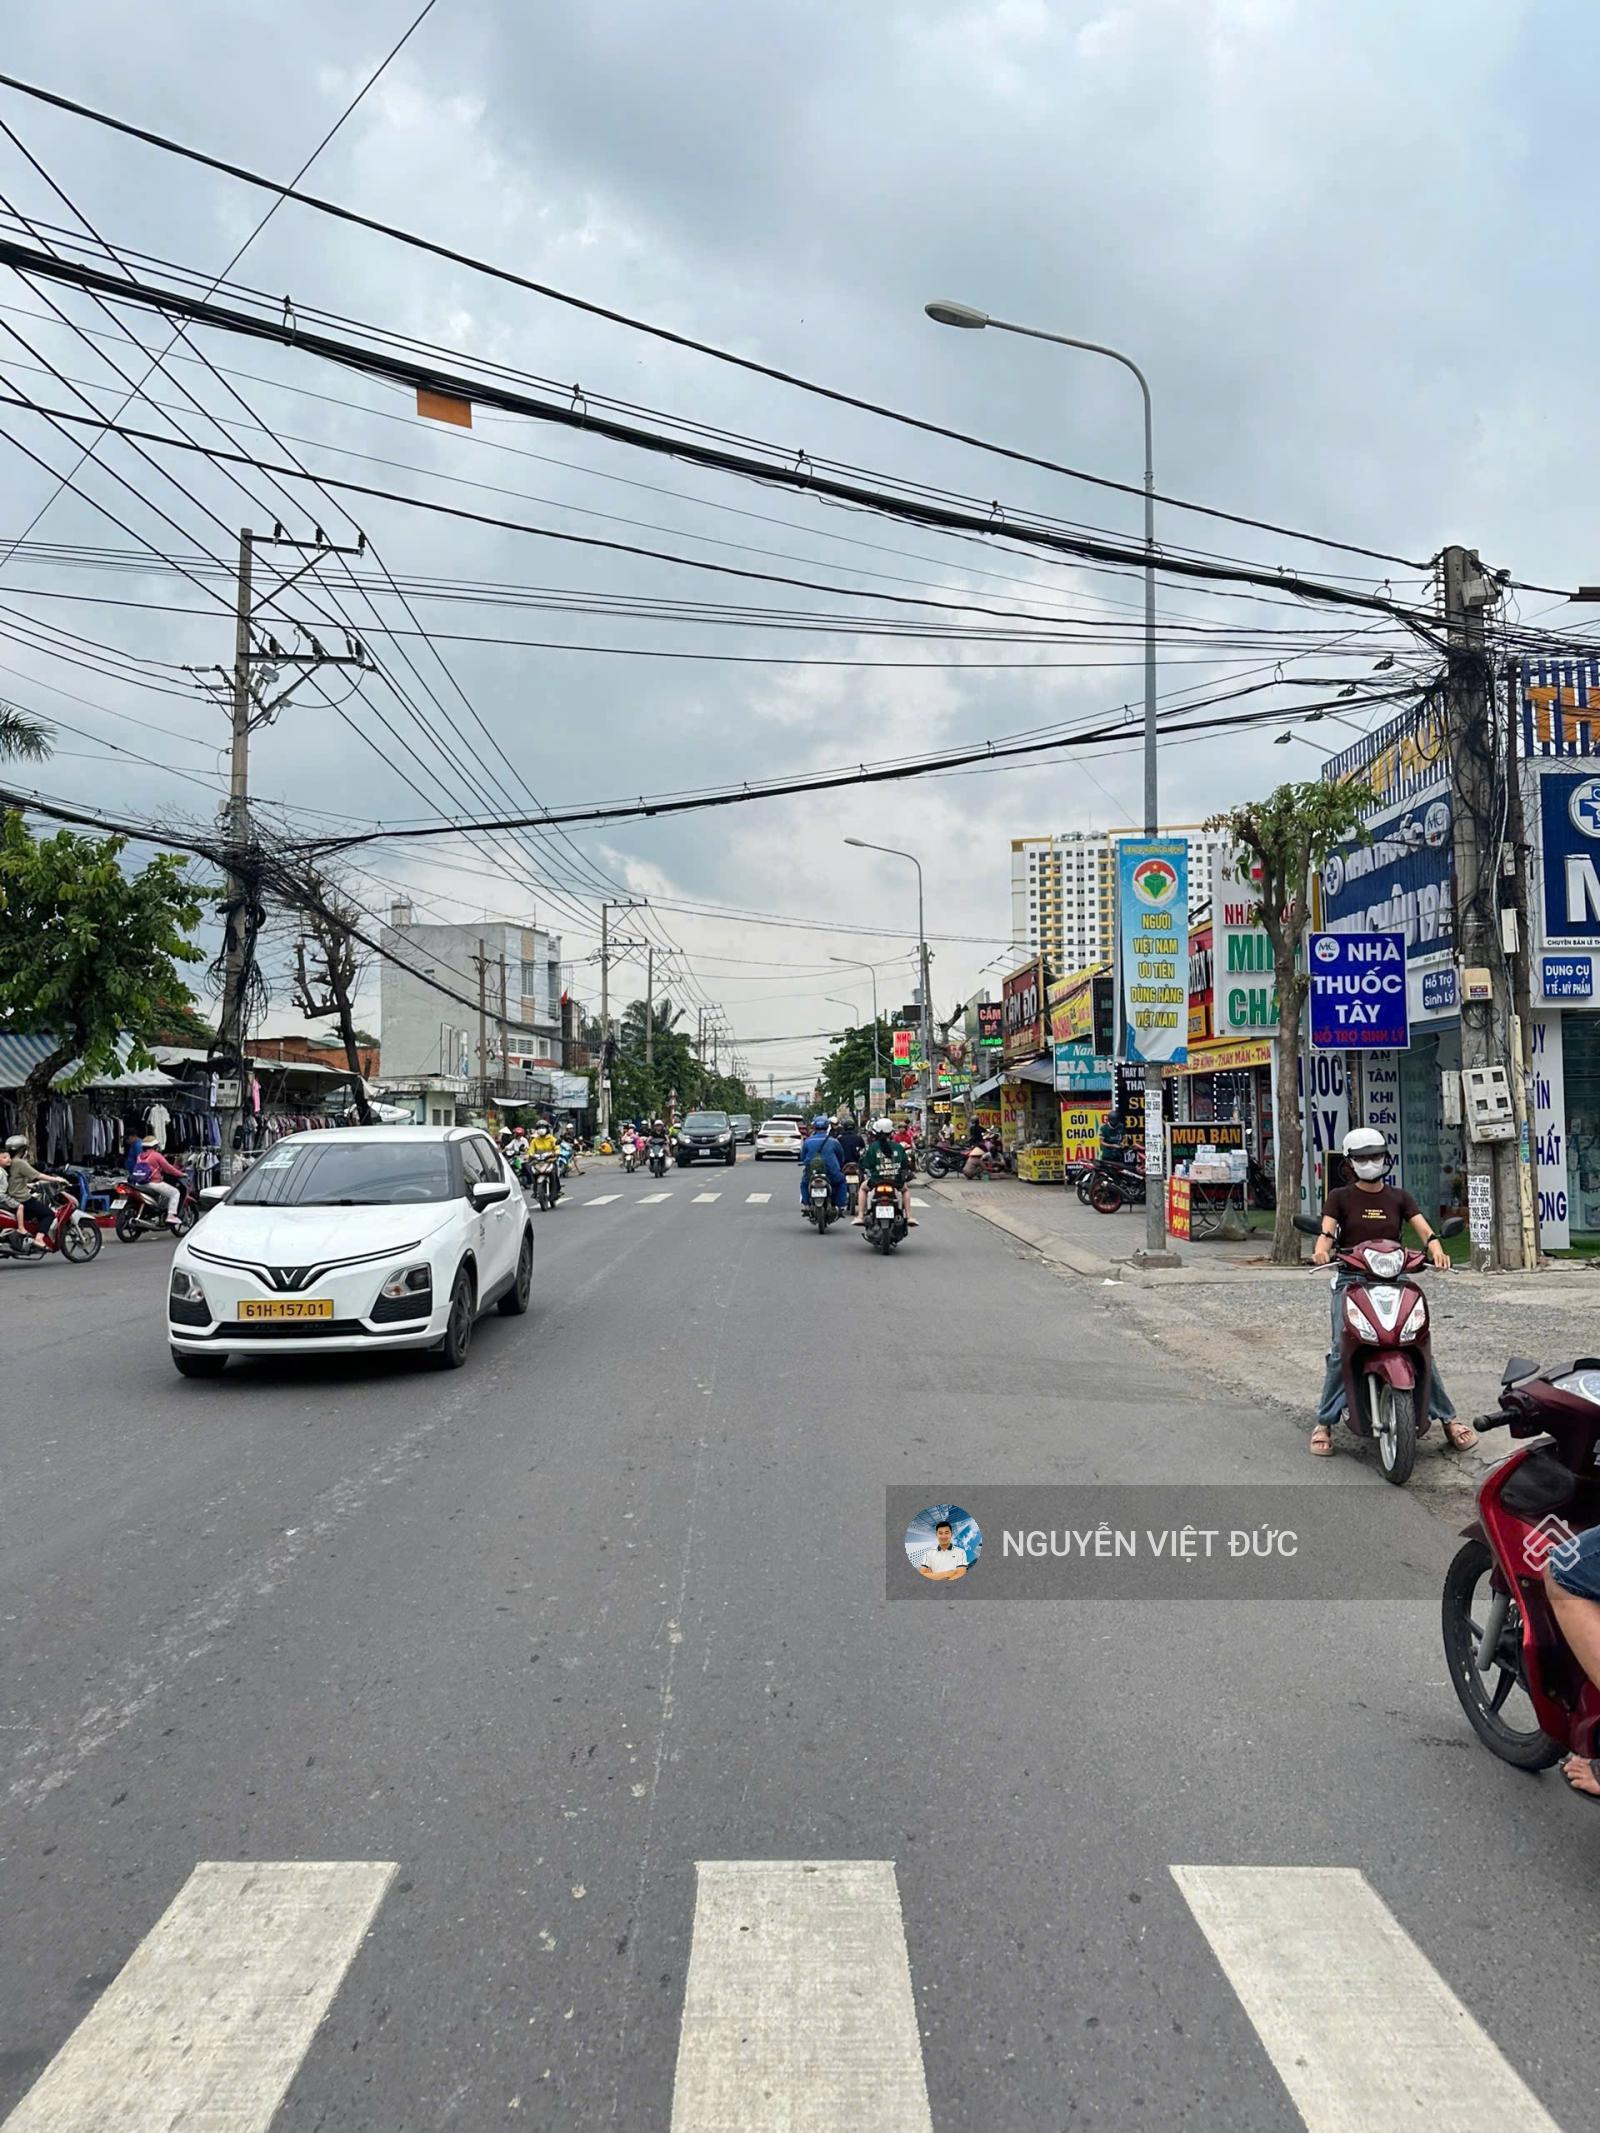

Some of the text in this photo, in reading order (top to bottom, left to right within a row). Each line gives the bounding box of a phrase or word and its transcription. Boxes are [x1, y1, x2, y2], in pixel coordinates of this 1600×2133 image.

[1142, 910, 1171, 929] NGƯỜI
[1133, 935, 1178, 957] VIỆT NAM
[1348, 938, 1401, 961] NHÀ
[1153, 960, 1175, 979] TIÊN
[1546, 965, 1590, 979] DỤNG CỤ
[1313, 967, 1402, 994] THUỐC
[1425, 974, 1453, 989] Hỗ Trợ
[1551, 979, 1558, 994] TẾ
[1130, 984, 1183, 1003] DÙNG HÀNG
[1425, 994, 1442, 1006] Sinh
[1445, 990, 1455, 1004] Lý
[1135, 1008, 1154, 1031] VIỆT
[1154, 1012, 1178, 1028] NAM
[1335, 1000, 1381, 1023] TÂY
[1361, 1030, 1389, 1043] SINH
[1256, 1046, 1271, 1060] THA
[1057, 1061, 1089, 1074] BIA
[1368, 1069, 1396, 1082] TÂM
[1370, 1092, 1393, 1103] KHI
[1534, 1072, 1551, 1109] ÍN
[1369, 1107, 1396, 1123] ĐẾN
[1172, 1126, 1240, 1144] MUA BÁN
[1536, 1123, 1561, 1165] HẤT
[246, 1304, 324, 1316] 61H-157.01
